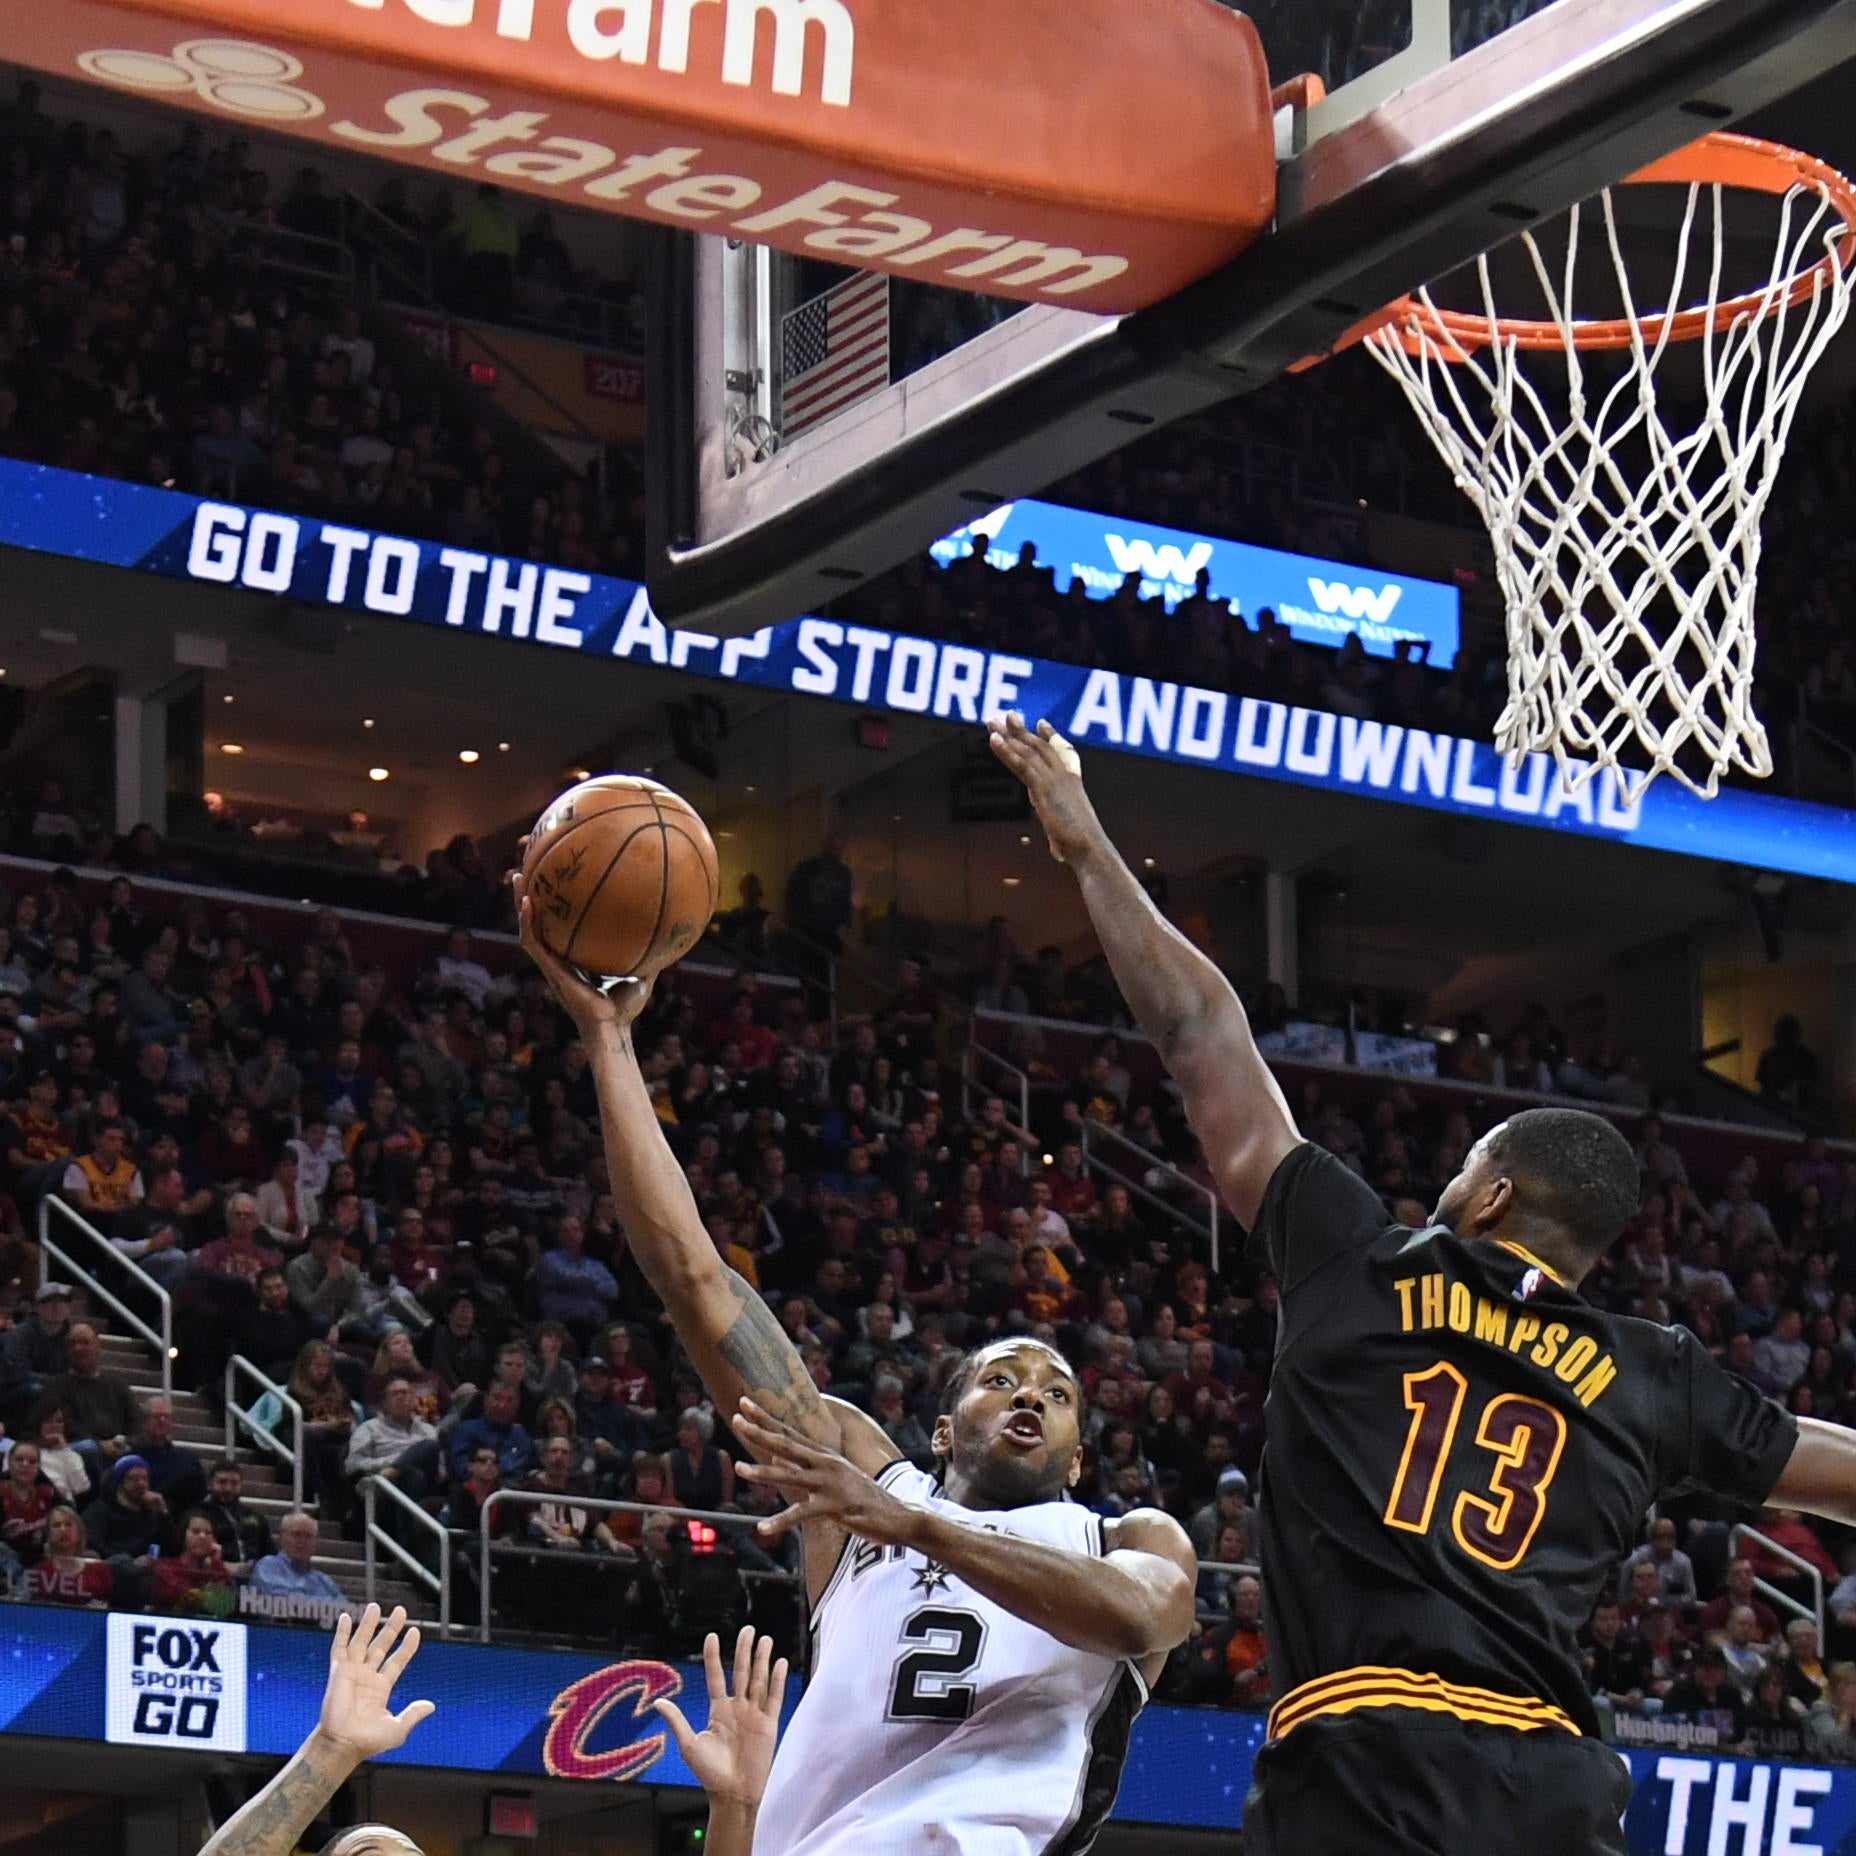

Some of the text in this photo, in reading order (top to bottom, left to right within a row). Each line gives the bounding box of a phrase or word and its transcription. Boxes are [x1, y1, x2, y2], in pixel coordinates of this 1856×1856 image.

[331, 88, 1130, 294] State Farm
[187, 501, 300, 594] GO
[320, 524, 420, 616] TO
[439, 548, 593, 648] THE
[792, 617, 1033, 723] STORE
[1069, 668, 1226, 761] AND
[1234, 695, 1643, 832] DOWNLOAD
[1393, 1273, 1618, 1408] THOMPSON
[1383, 1359, 1567, 1570] 13
[7, 1567, 93, 1599] LEVEL
[130, 1670, 224, 1695] SPORTS
[133, 1625, 222, 1674] FOX
[883, 1604, 991, 1723] 2
[133, 1692, 220, 1738] GO
[1615, 1712, 1719, 1746] Huntington
